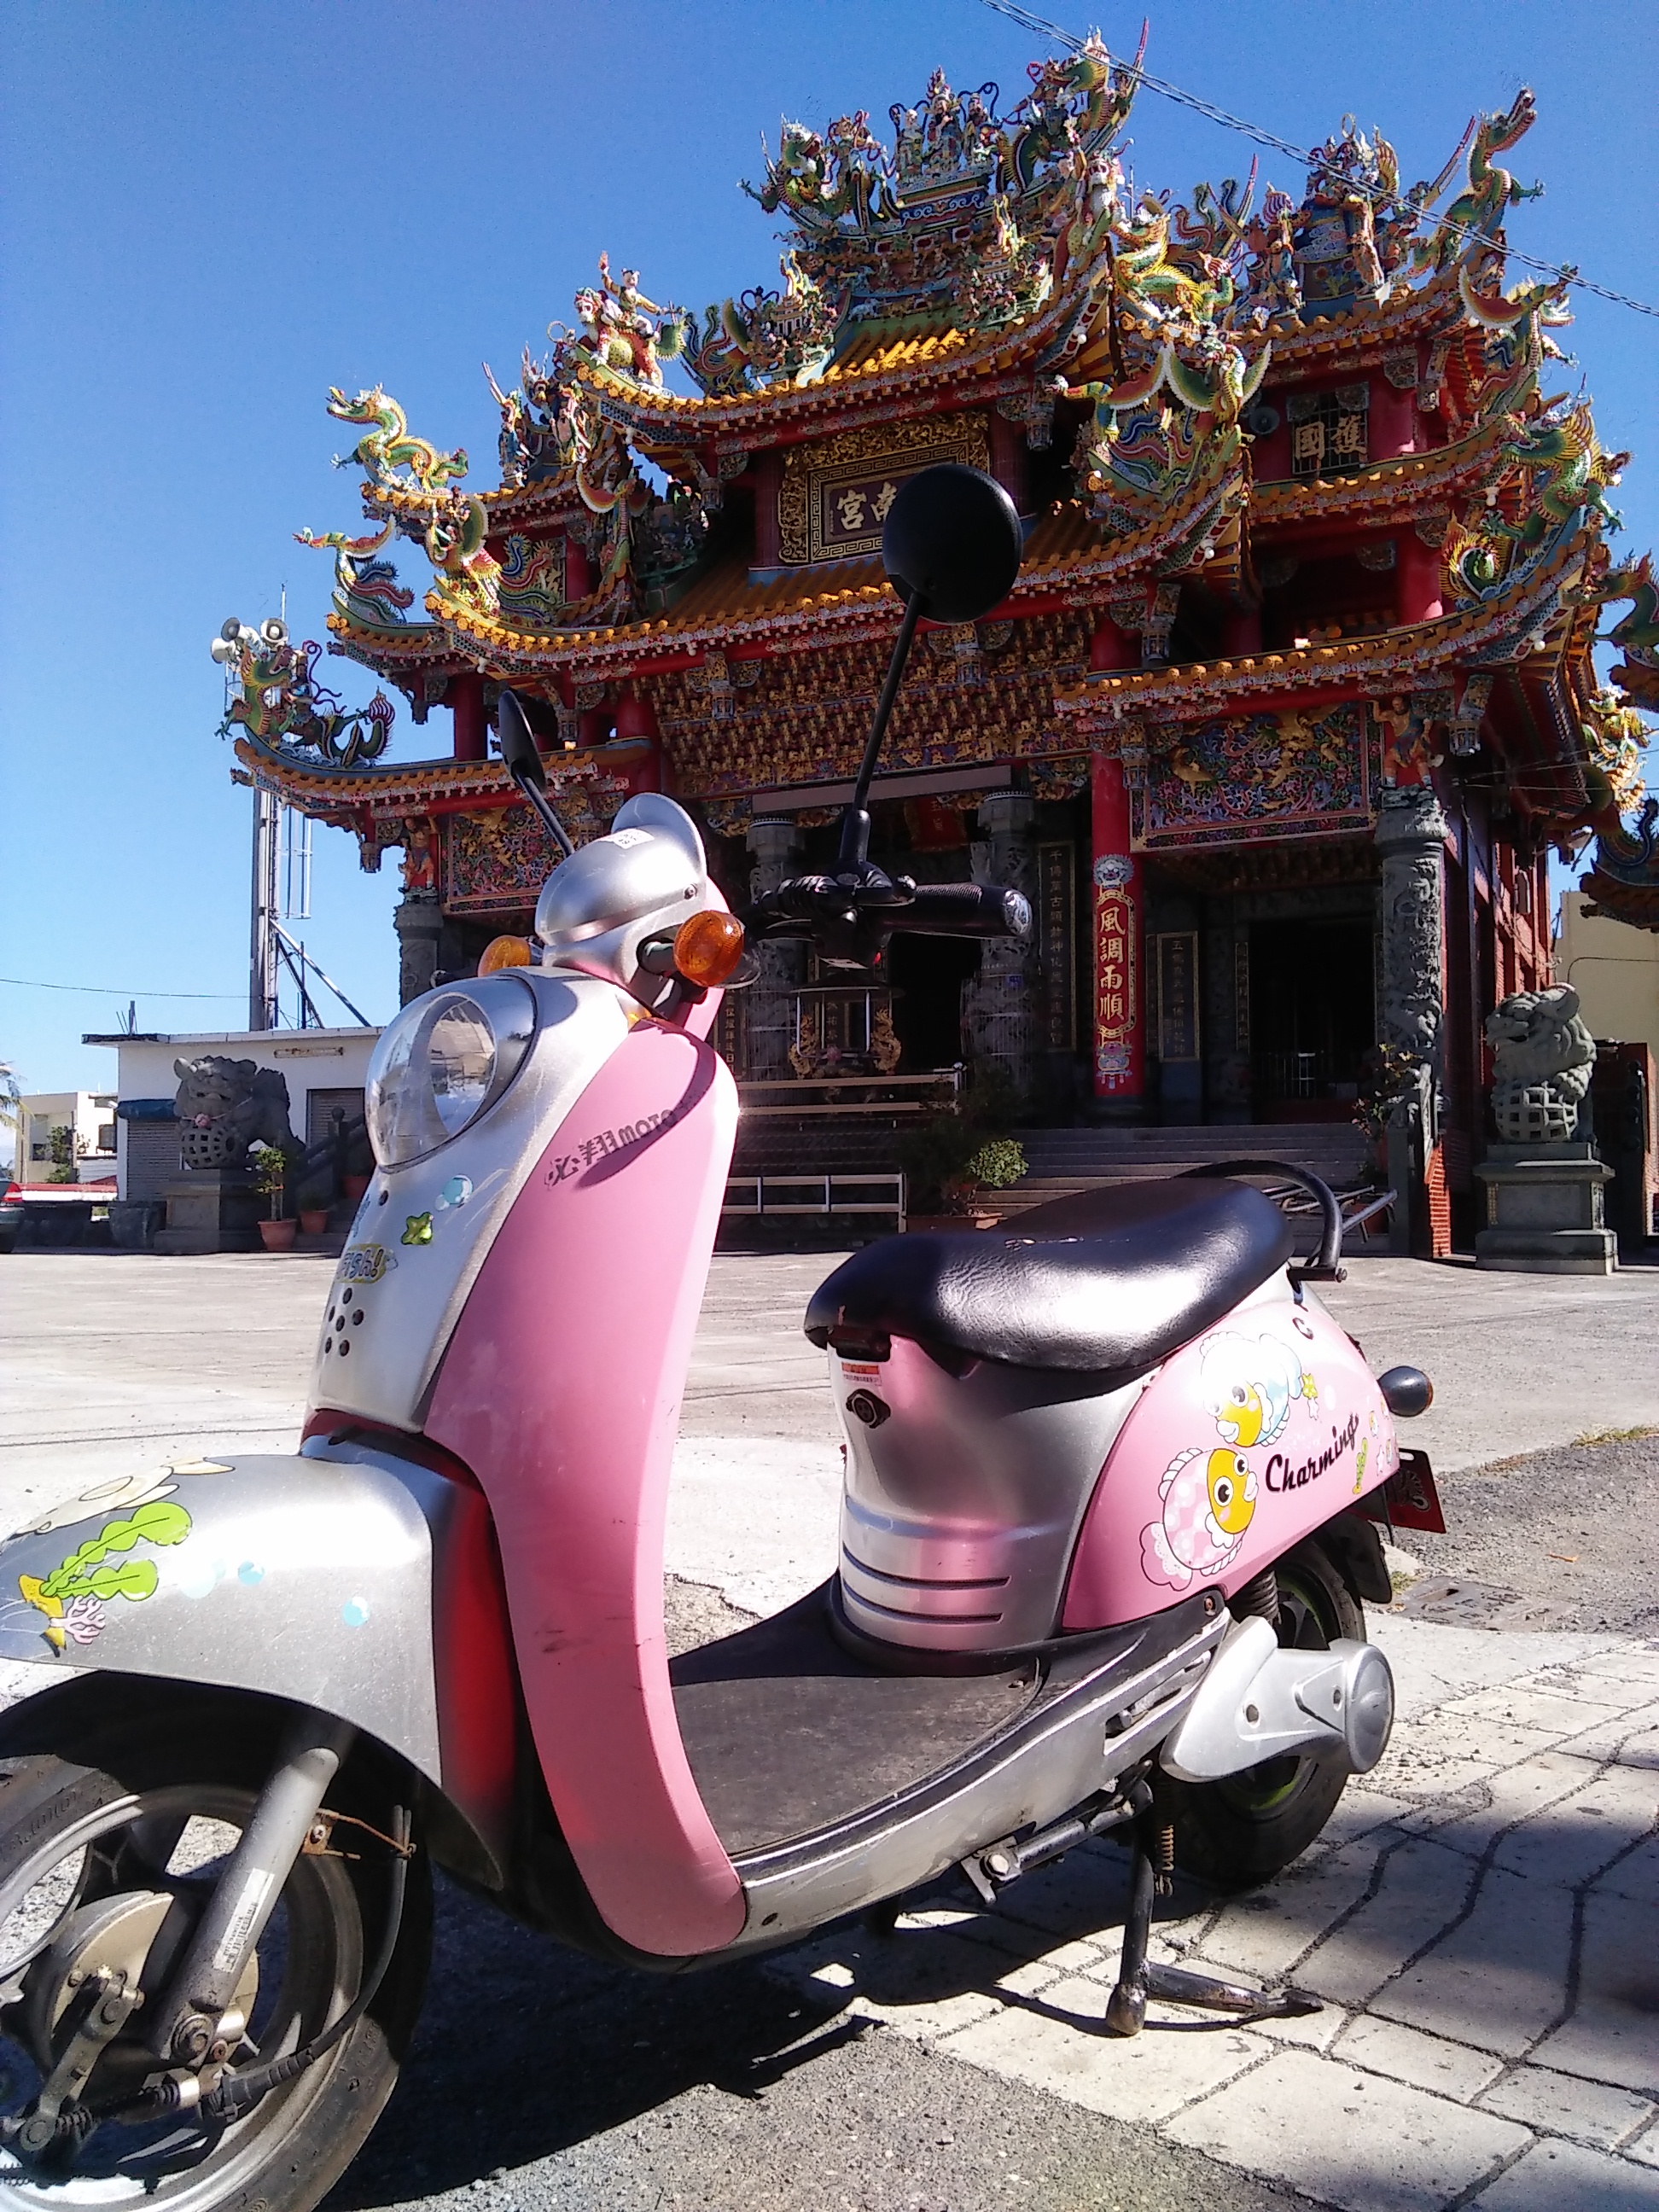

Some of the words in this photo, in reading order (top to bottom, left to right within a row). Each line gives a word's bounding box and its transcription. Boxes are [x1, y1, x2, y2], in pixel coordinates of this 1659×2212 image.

[1099, 905, 1126, 1021] 風調雨順
[1266, 1412, 1359, 1493] Charming
